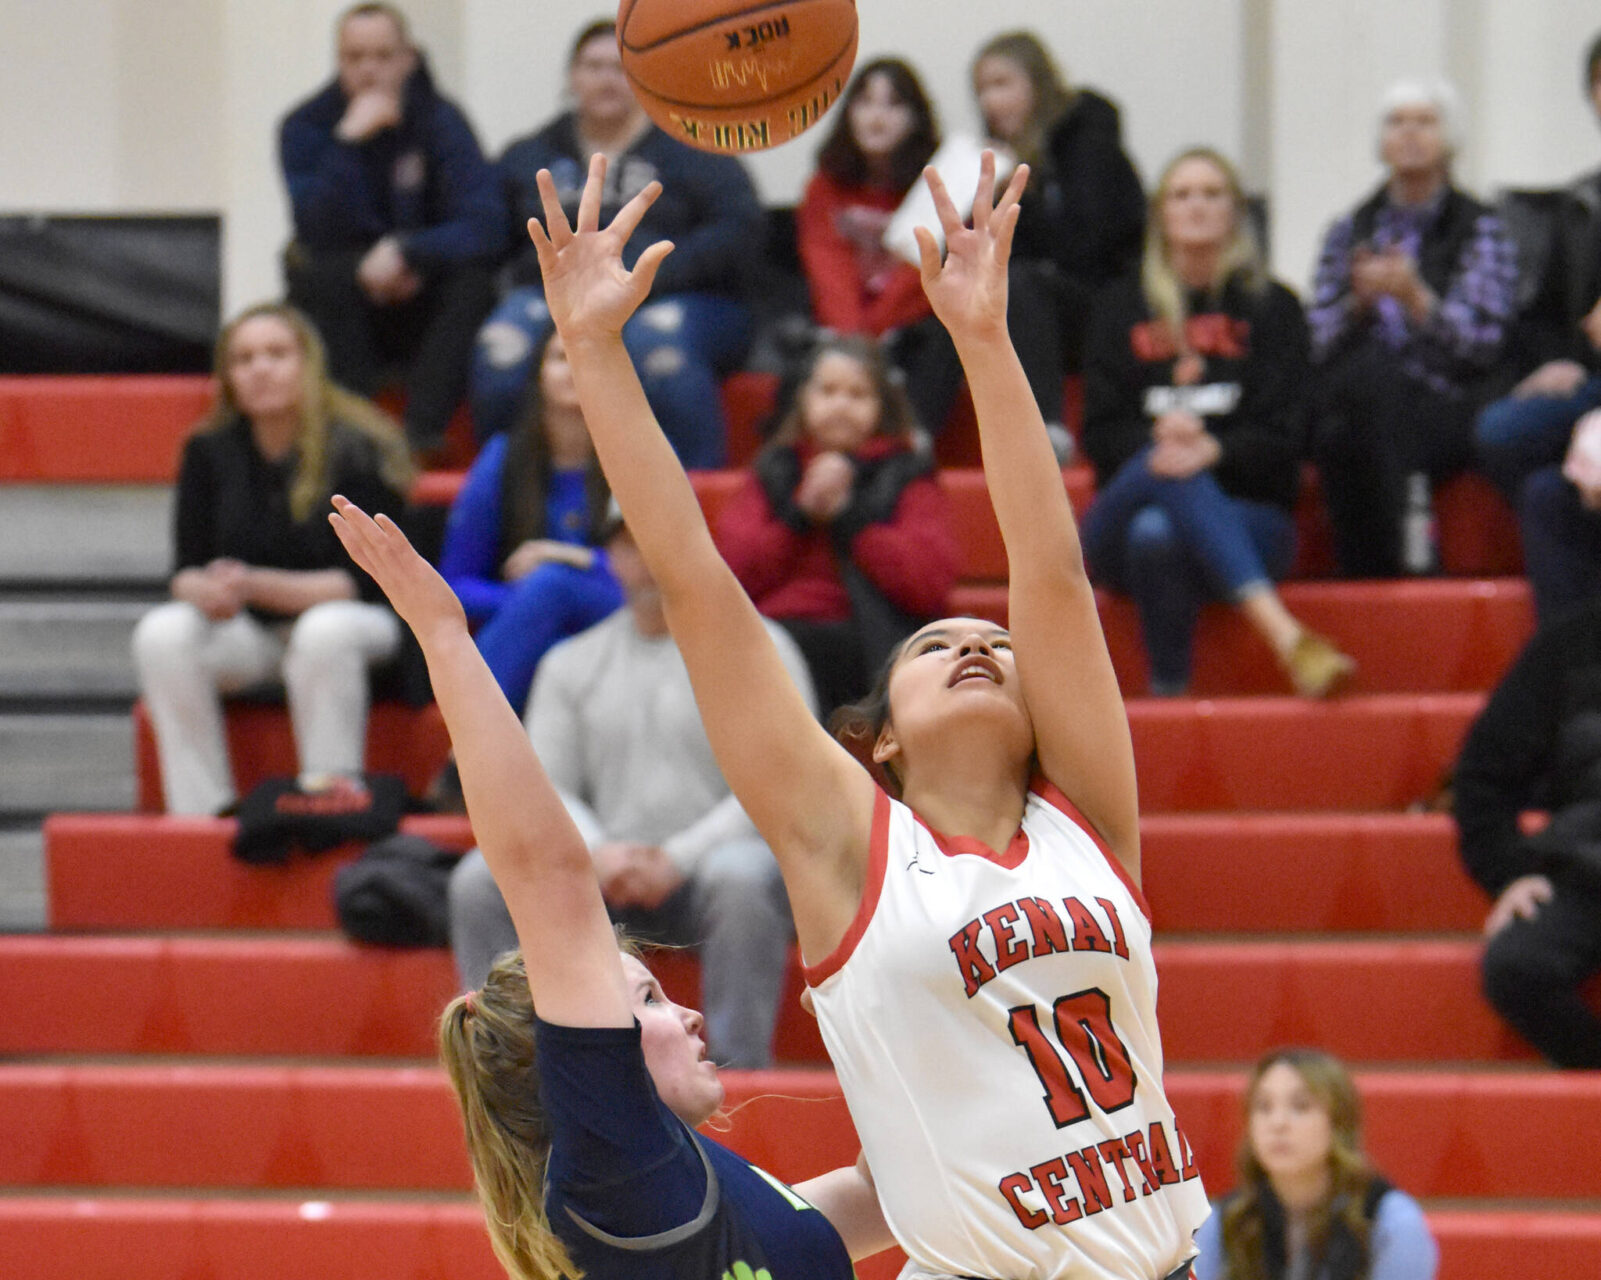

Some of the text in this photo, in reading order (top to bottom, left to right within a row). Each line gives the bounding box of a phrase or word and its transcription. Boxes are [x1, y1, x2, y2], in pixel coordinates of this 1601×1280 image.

[948, 896, 1130, 998] KENAI
[1008, 986, 1137, 1129] 10
[998, 1117, 1199, 1230] CENTRAL
